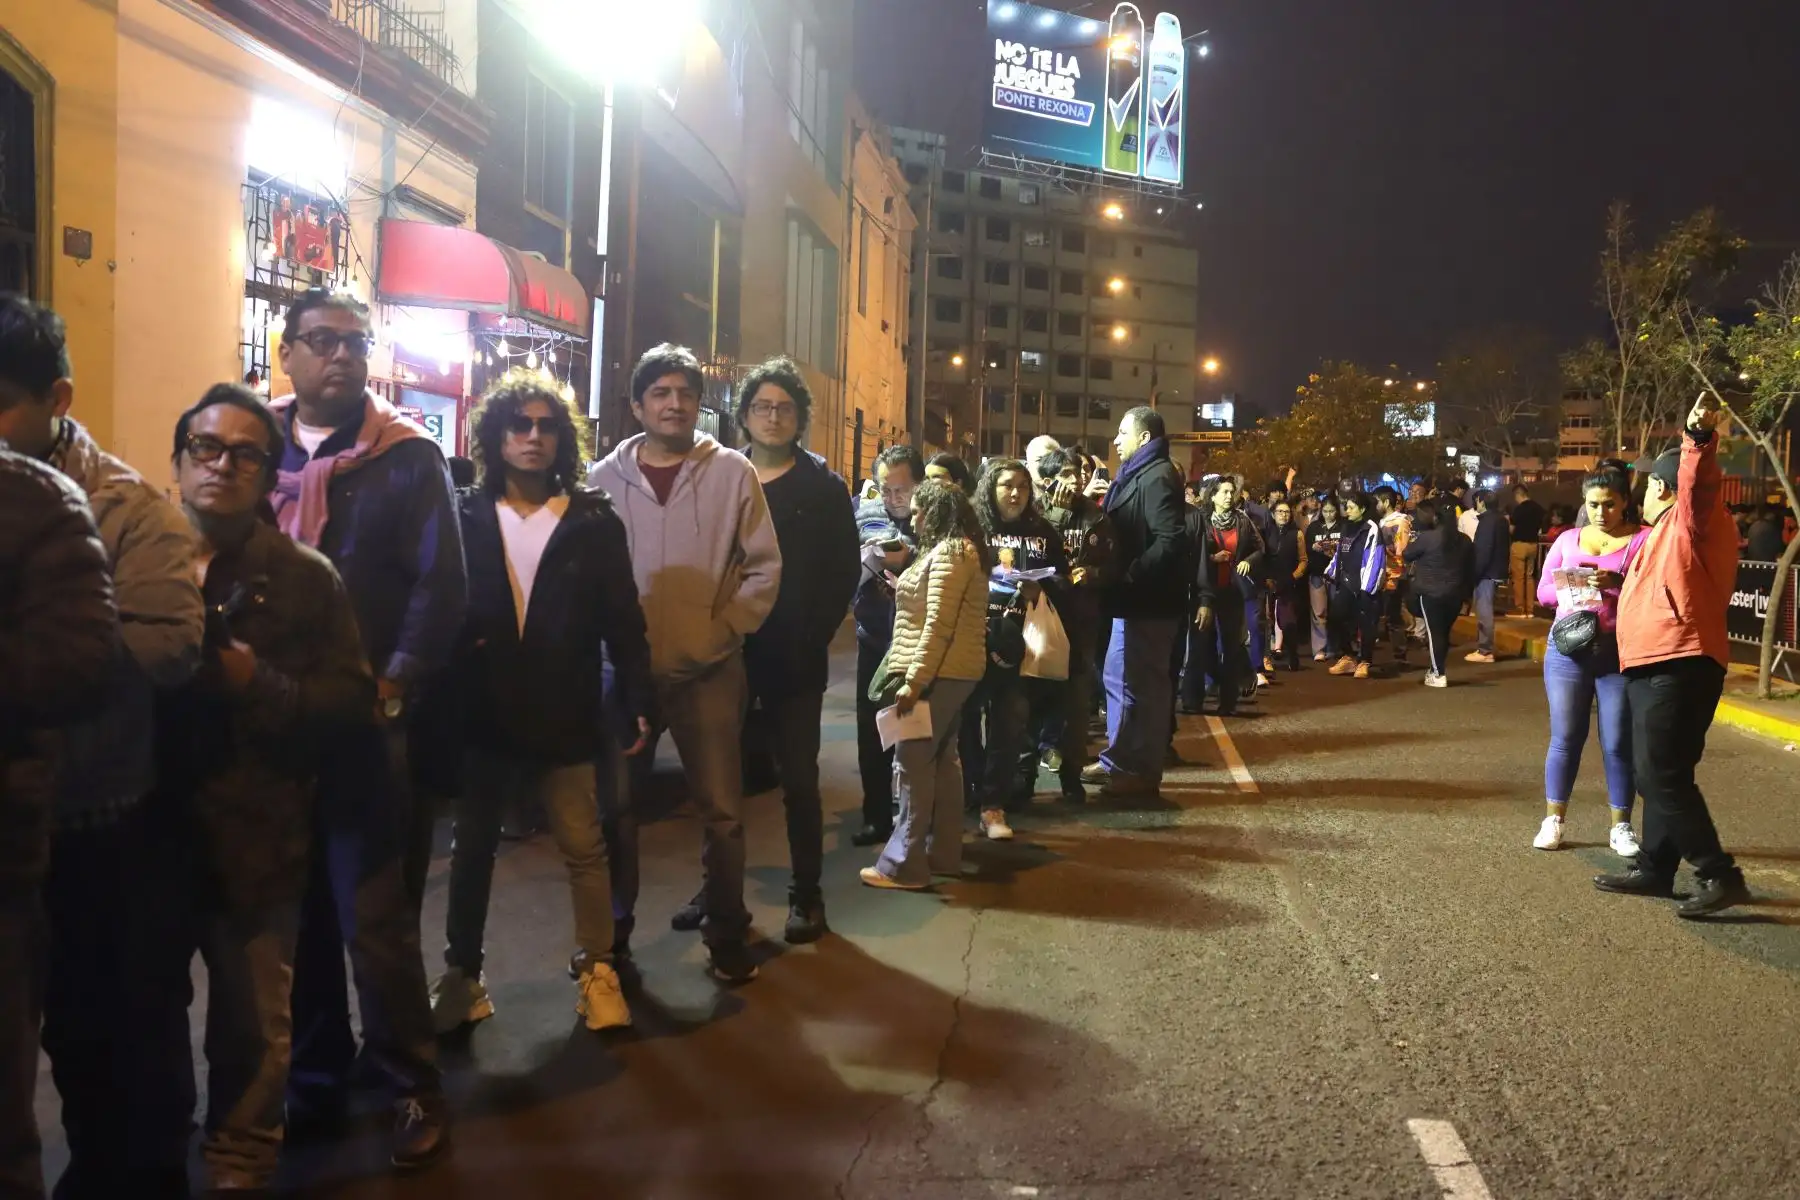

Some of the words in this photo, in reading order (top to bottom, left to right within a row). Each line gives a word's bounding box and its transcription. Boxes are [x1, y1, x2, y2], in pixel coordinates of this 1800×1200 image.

[995, 38, 1027, 66] NO
[1029, 46, 1053, 72] TE
[1056, 52, 1081, 79] LA
[993, 63, 1076, 100] JUEGUES
[997, 89, 1036, 109] PONTE
[1038, 96, 1086, 119] REXONA
